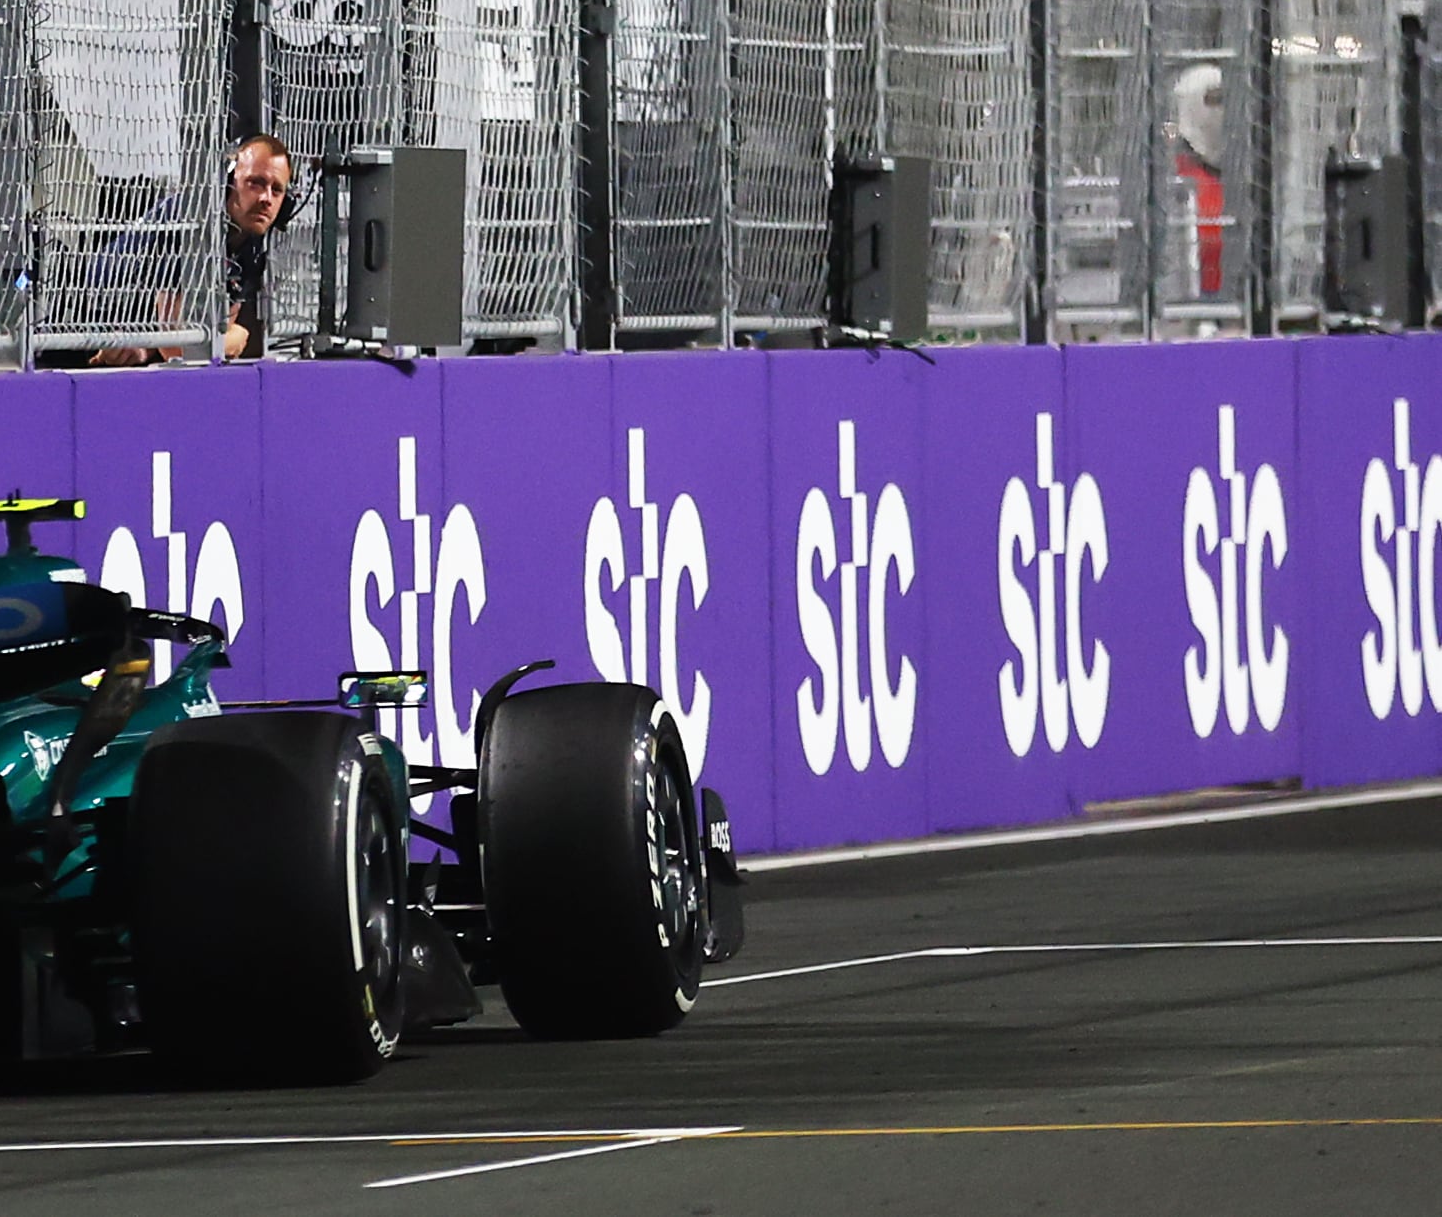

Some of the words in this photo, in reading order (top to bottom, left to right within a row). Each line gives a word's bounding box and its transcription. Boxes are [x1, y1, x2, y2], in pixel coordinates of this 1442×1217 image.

[797, 420, 916, 775] stc
[999, 413, 1110, 757] stc
[1184, 405, 1289, 738] stc
[646, 771, 664, 912] ZERO
[710, 821, 731, 854] BOSS
